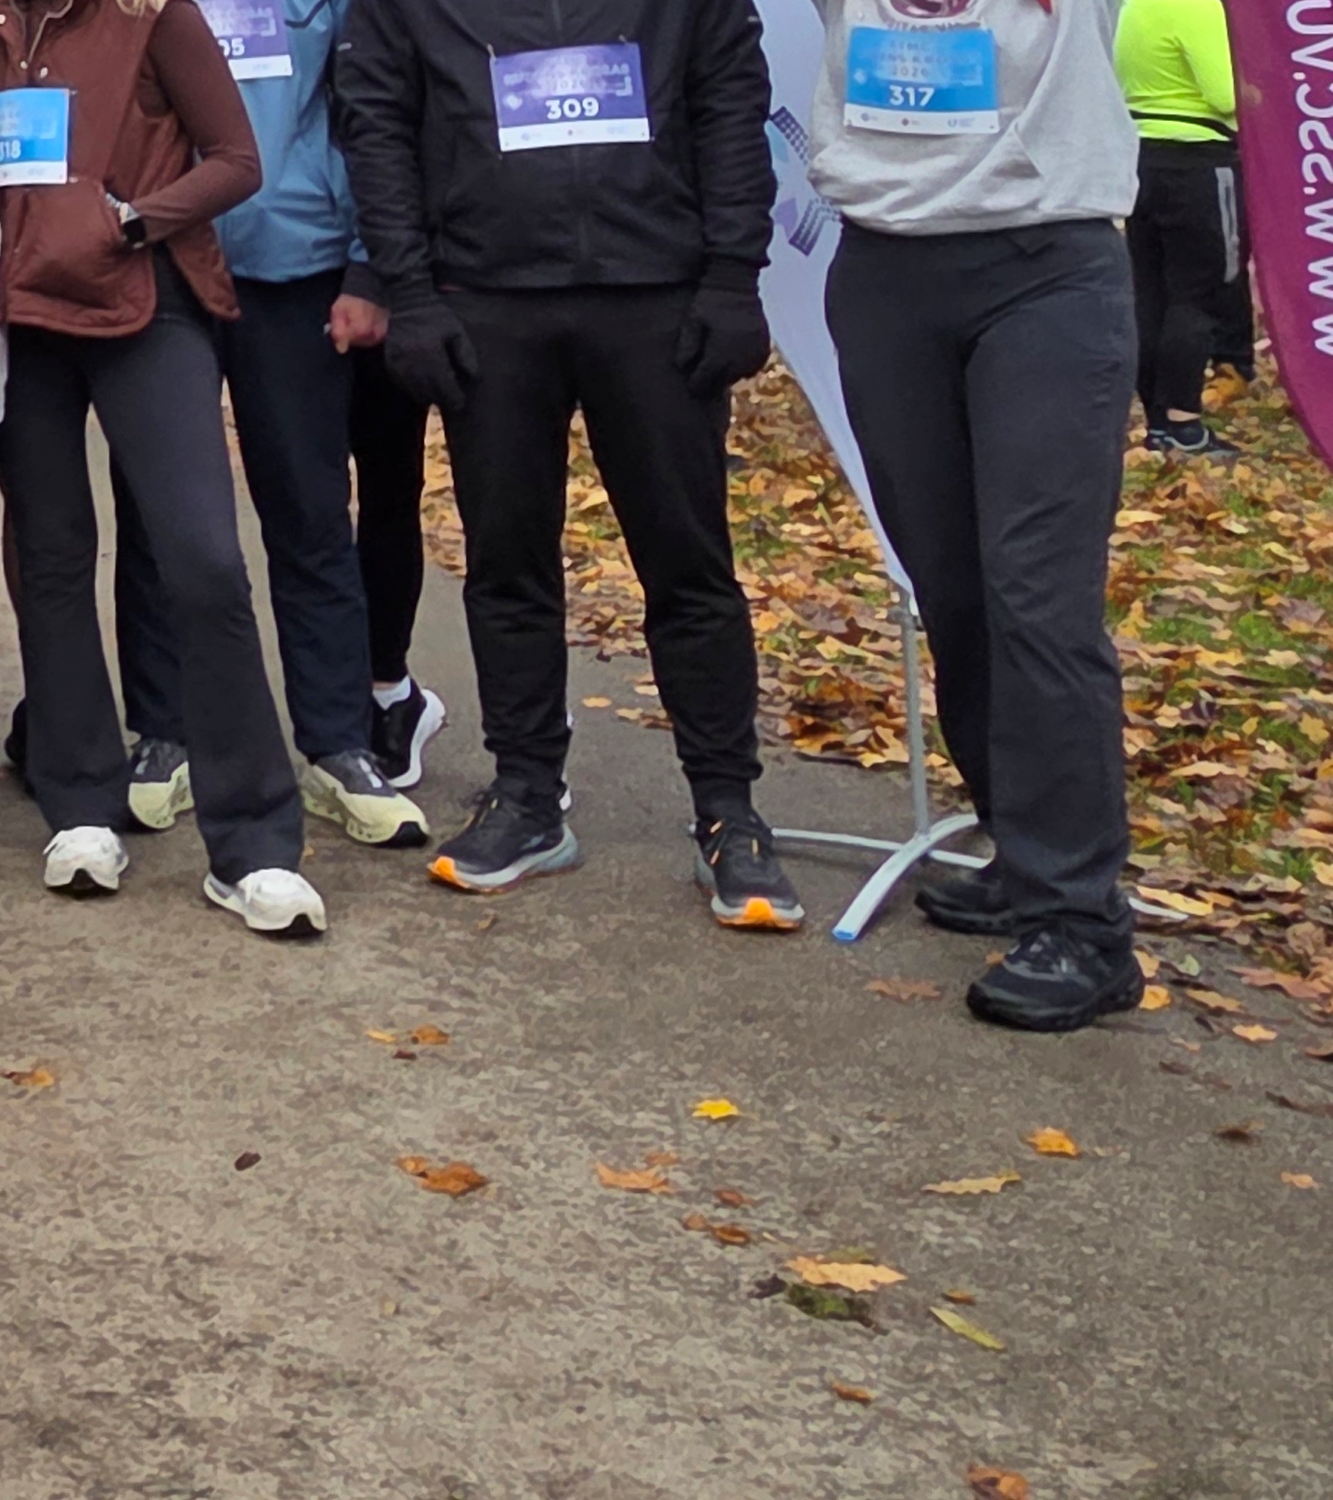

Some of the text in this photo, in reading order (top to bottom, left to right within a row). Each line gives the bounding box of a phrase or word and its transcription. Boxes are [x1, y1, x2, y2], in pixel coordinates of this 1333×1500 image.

[218, 37, 245, 57] 05
[889, 85, 935, 107] 317
[545, 97, 599, 120] 309
